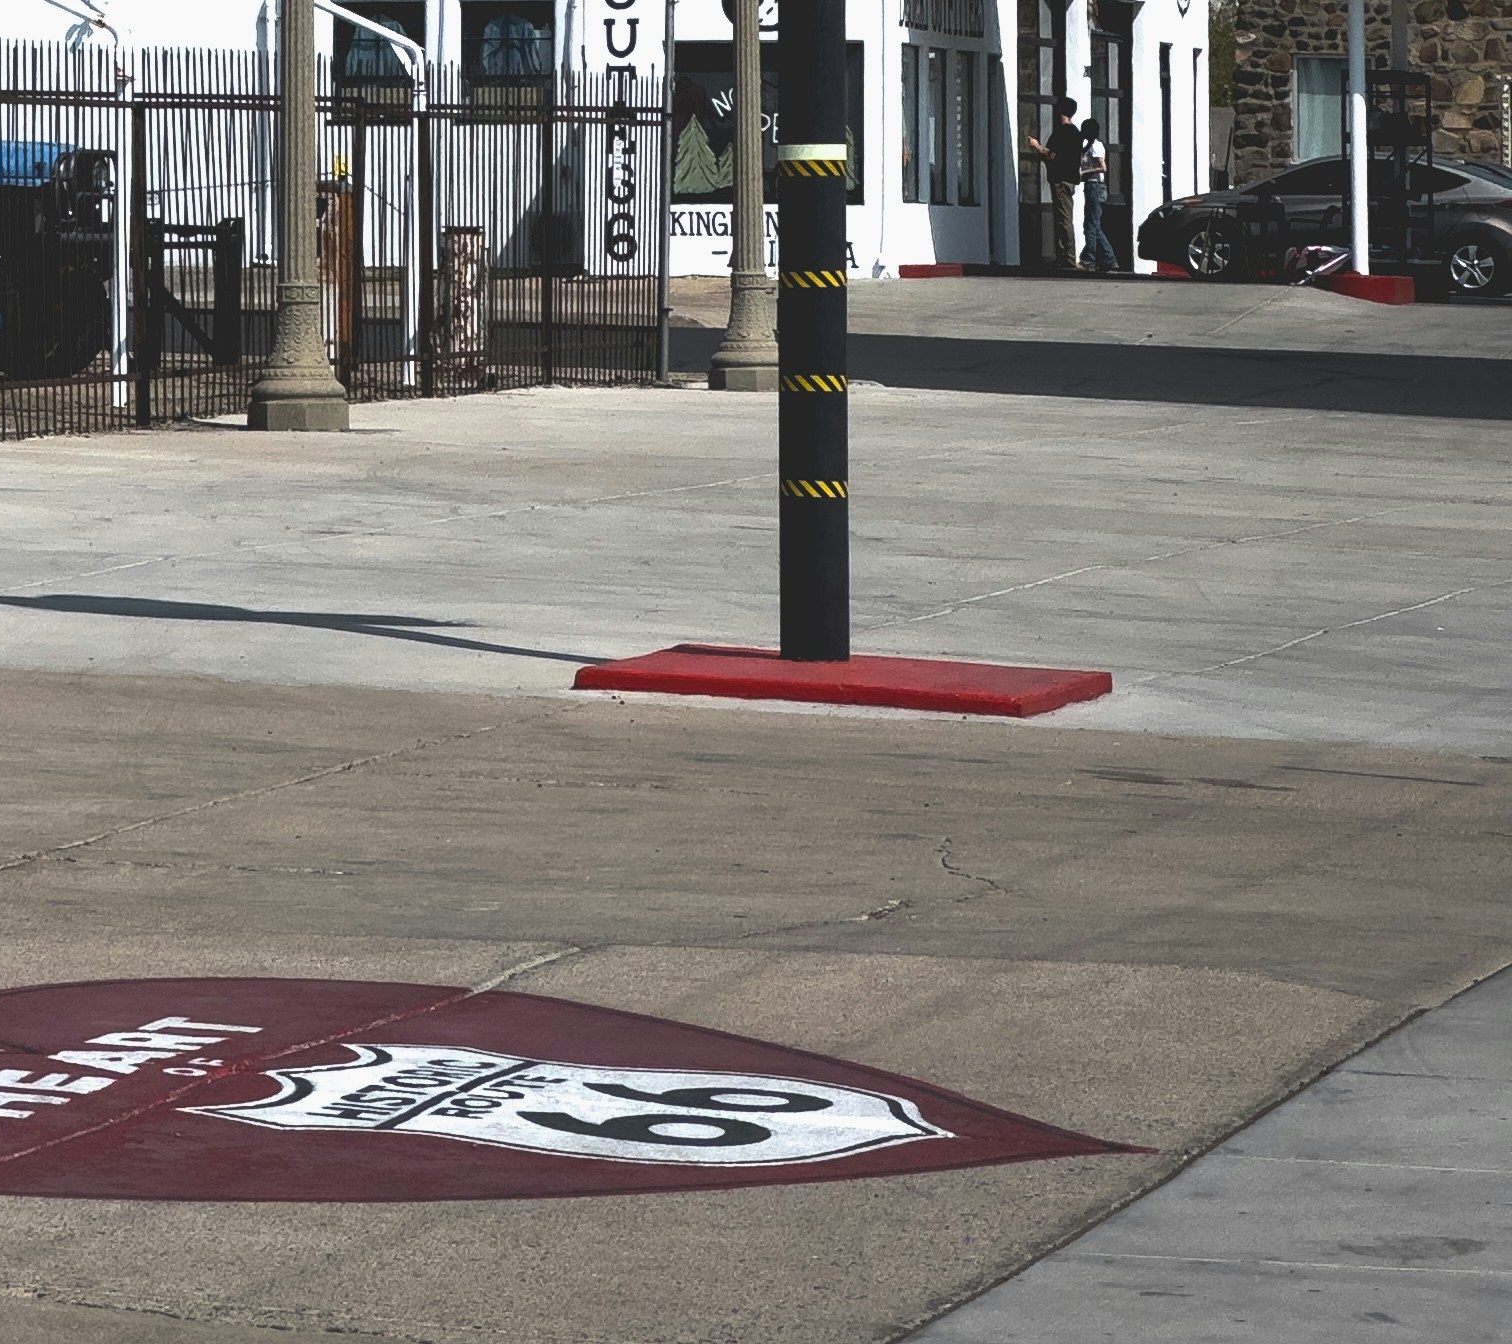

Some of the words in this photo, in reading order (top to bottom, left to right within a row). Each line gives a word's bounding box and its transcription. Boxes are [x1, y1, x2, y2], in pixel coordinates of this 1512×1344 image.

[161, 1056, 226, 1077] OF
[305, 1059, 499, 1122] HISTORIC
[430, 1073, 568, 1120] ROUTE
[516, 1082, 835, 1148] 66
